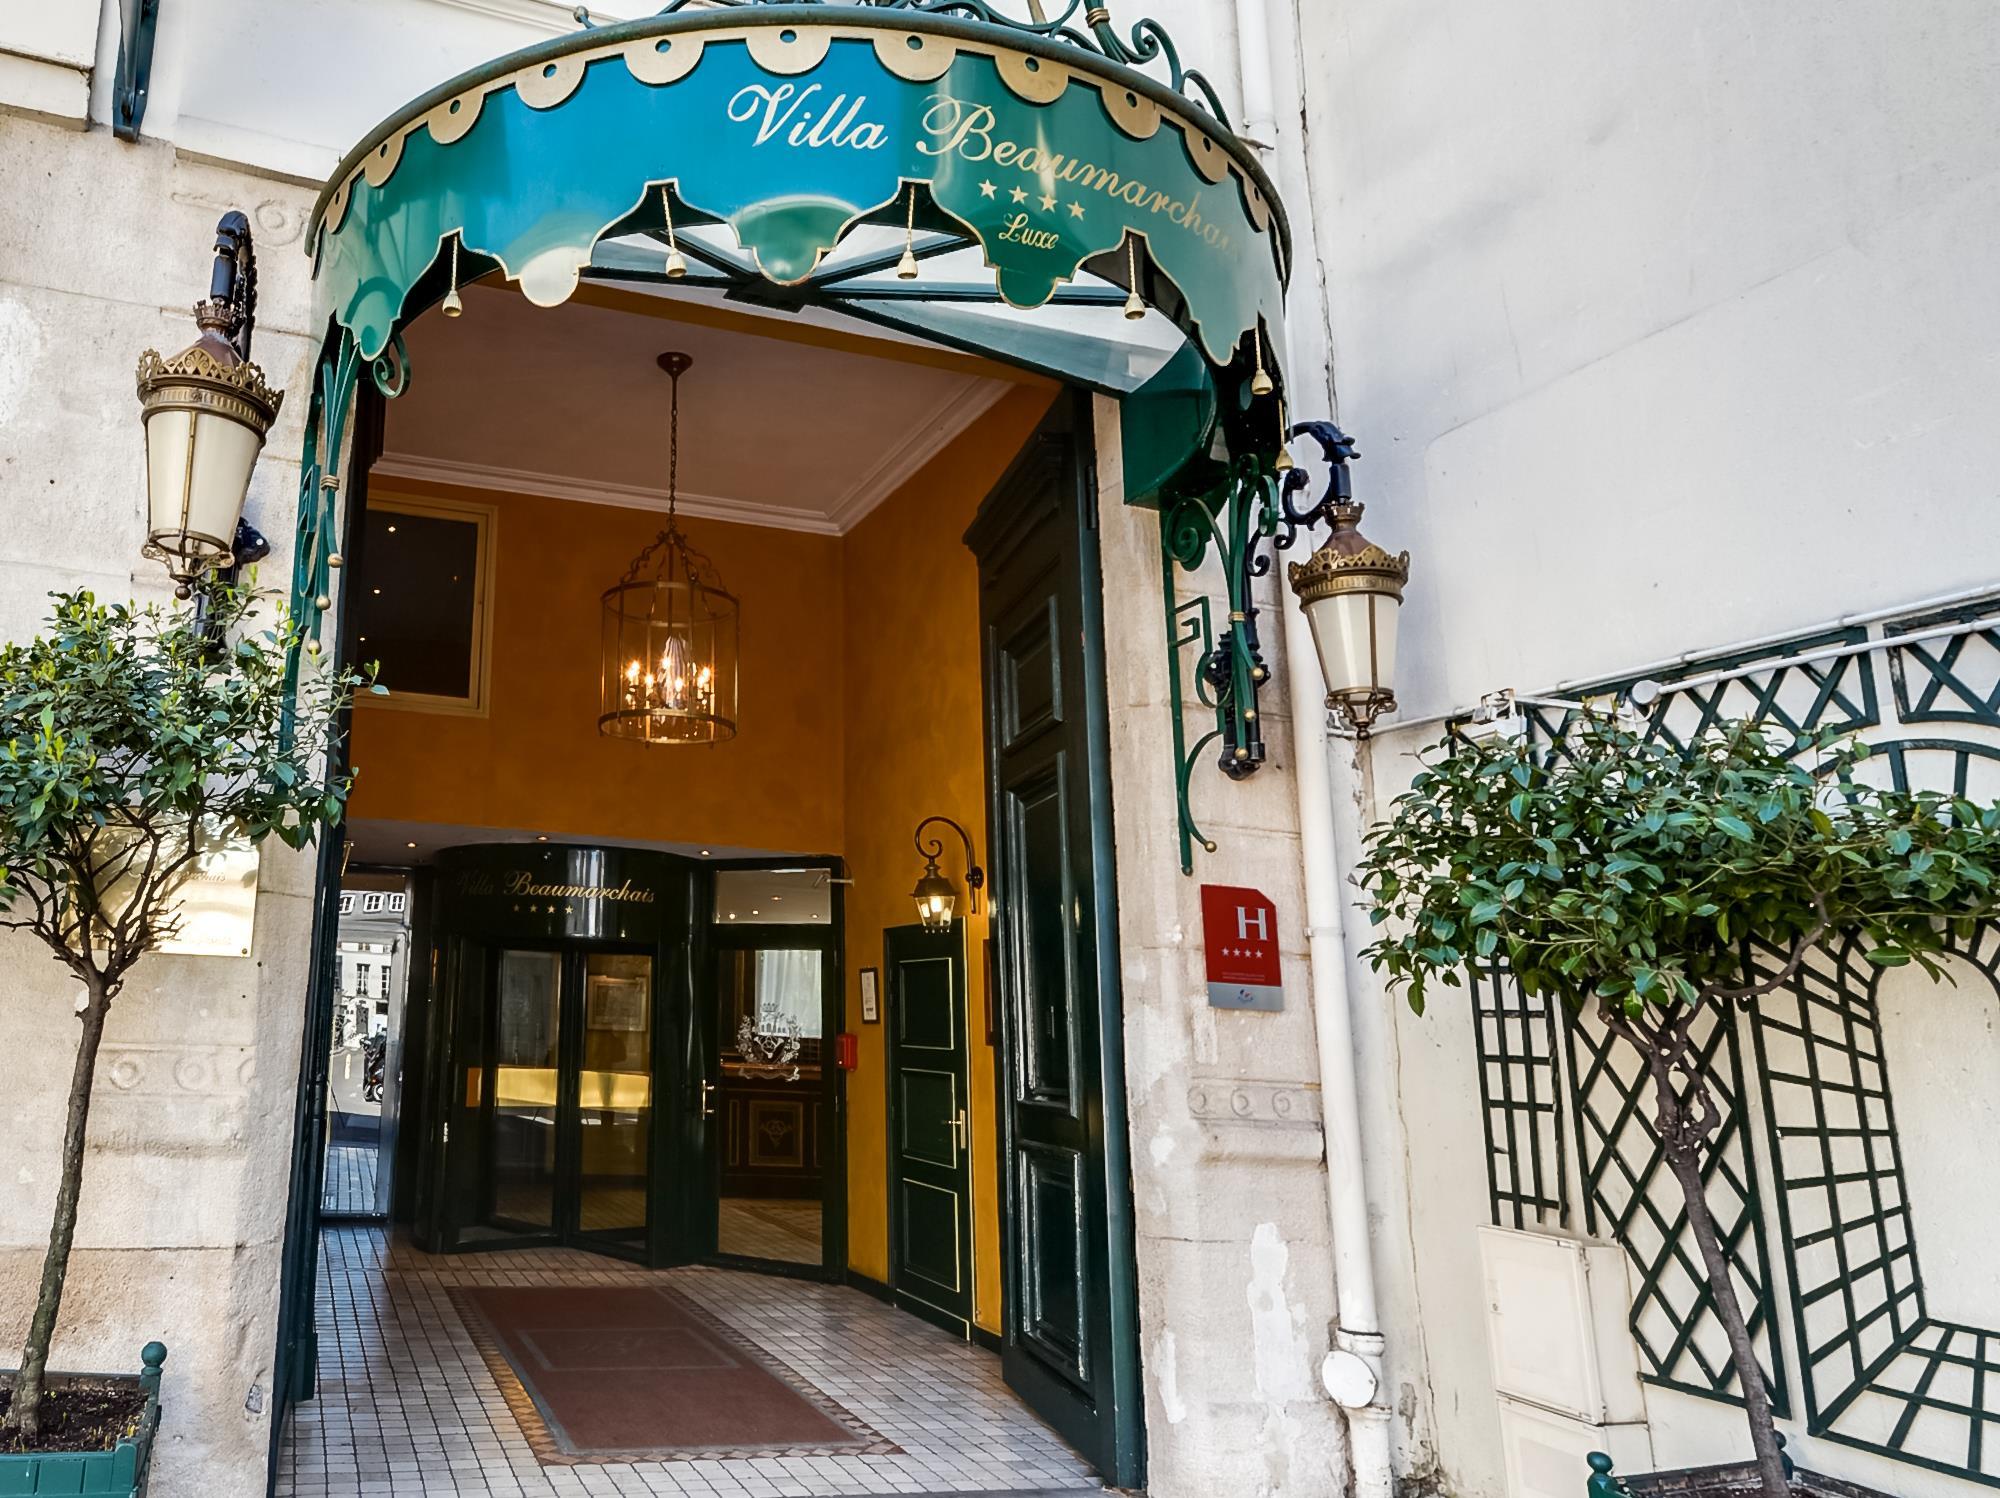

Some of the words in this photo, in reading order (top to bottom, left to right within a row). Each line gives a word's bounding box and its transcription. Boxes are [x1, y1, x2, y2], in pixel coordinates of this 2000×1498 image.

[727, 83, 889, 150] Villa
[915, 94, 1240, 263] Beaumarchai
[998, 212, 1060, 251] Luxe
[456, 865, 495, 896] Villa
[503, 870, 655, 903] Beaumarchais
[1237, 906, 1268, 941] H
